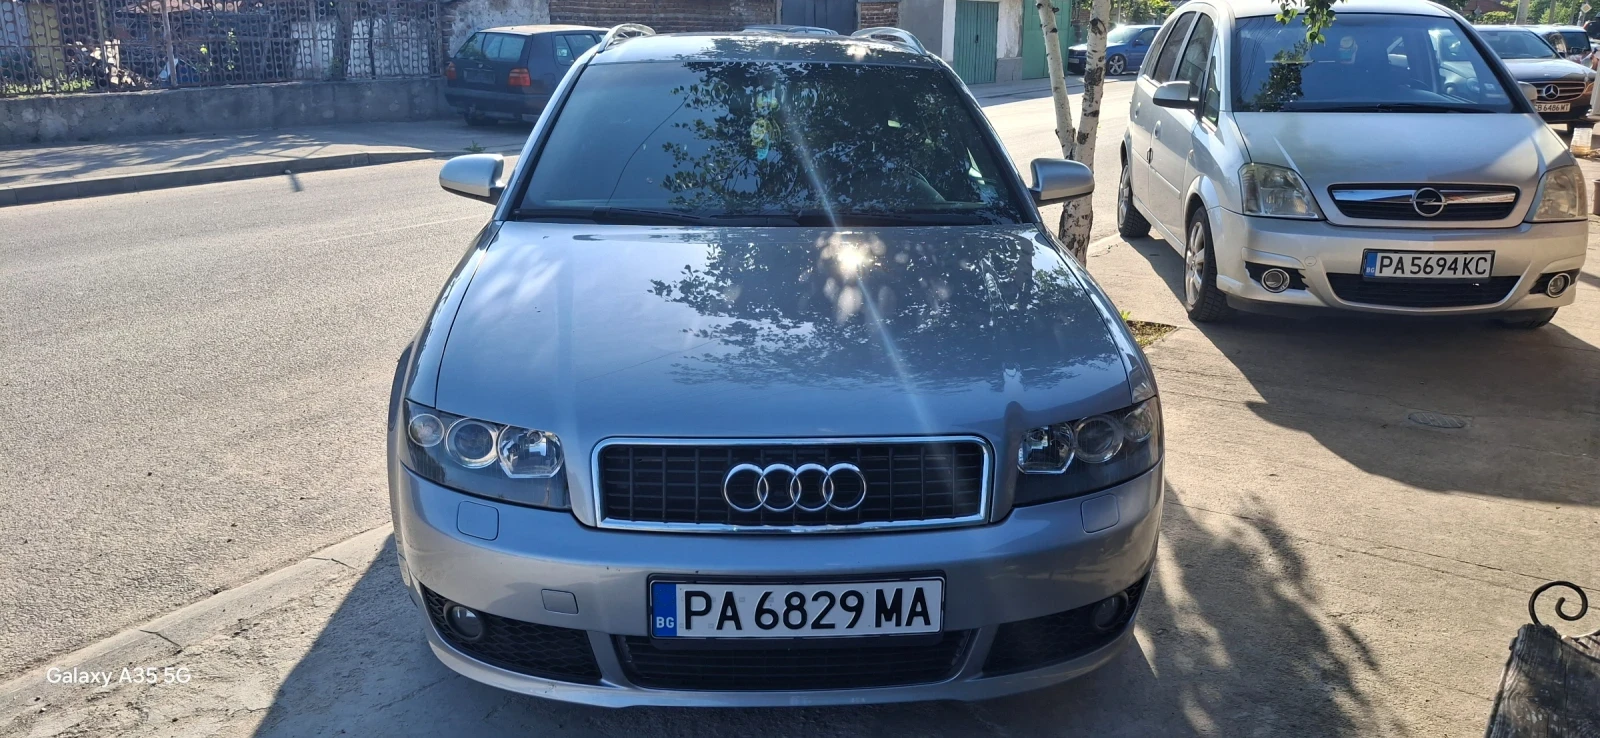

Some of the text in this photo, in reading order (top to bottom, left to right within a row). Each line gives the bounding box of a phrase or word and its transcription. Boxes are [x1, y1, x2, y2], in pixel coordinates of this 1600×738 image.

[1379, 255, 1488, 276] PA 5694 KC
[684, 587, 931, 631] PA 6829 MA
[656, 616, 675, 629] BG
